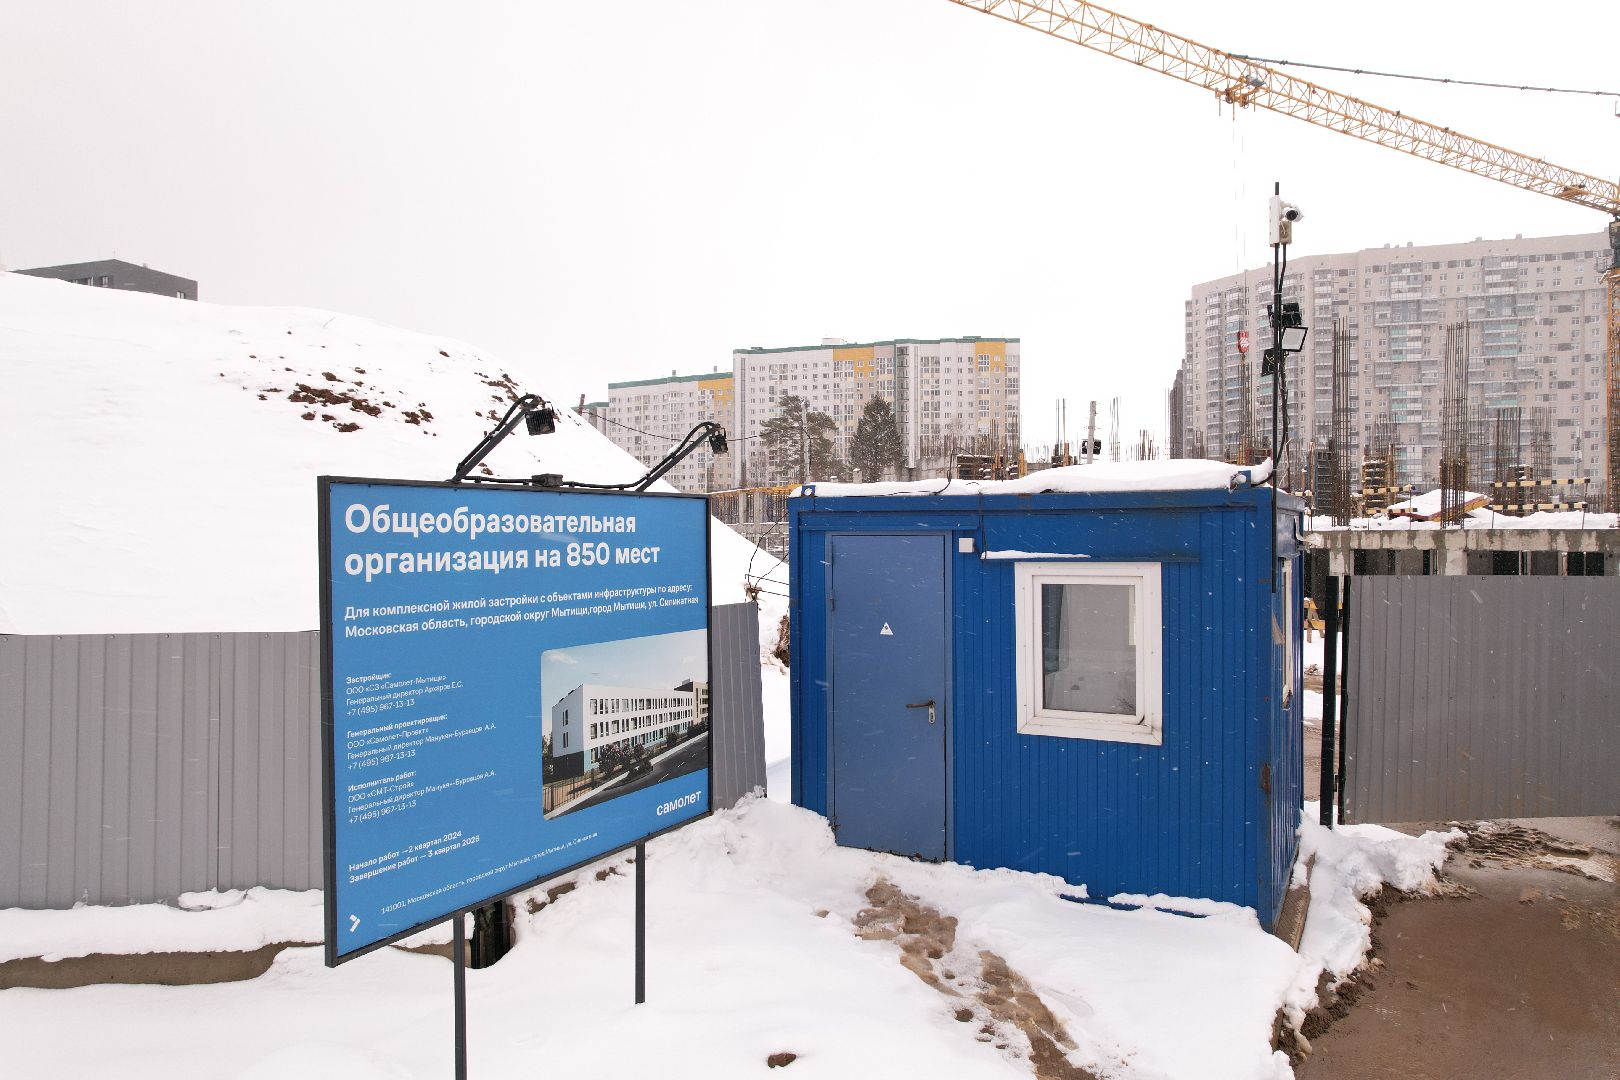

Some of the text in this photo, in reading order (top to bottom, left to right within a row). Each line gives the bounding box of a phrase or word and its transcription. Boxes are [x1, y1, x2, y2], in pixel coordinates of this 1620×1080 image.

[345, 503, 636, 539] Общеобразовательная
[345, 542, 660, 582] организация на 850 мест
[344, 606, 370, 621] Для
[372, 599, 450, 617] комплексной
[452, 597, 486, 610] жилой
[488, 593, 539, 608] застройки
[547, 591, 593, 602] объектами
[594, 586, 657, 600] инфраструктуры
[658, 586, 667, 594] по
[667, 584, 693, 593] адресу:
[345, 622, 419, 638] Московская
[422, 618, 468, 631] область,
[470, 610, 522, 628] городской
[524, 611, 549, 622] округ
[614, 601, 647, 612] Мытищи,
[648, 600, 658, 610] ул.
[659, 596, 699, 607] Силикатная
[346, 672, 392, 684] Застройщик:
[346, 687, 363, 695] ООО
[347, 692, 392, 706] Генеральный
[393, 688, 423, 699] директор
[347, 699, 415, 716] +7 (495) 967-13-13
[347, 714, 447, 738] Генеральный проектировщик:
[347, 745, 392, 760] Генеральный
[393, 738, 424, 750] директор
[484, 722, 496, 730] А.А.
[347, 741, 365, 749] ООО
[348, 749, 416, 770] +7 (495) 967-13-13
[348, 770, 417, 792] Исполнитель работ:
[348, 797, 393, 813] Генеральный
[394, 789, 425, 801] директор
[484, 770, 496, 778] А.А.
[348, 793, 365, 803] ООО
[657, 791, 701, 816] самолет
[349, 800, 417, 824] +7 (495) 967-13-13
[349, 858, 377, 872] Начало
[378, 851, 400, 864] работ
[414, 838, 441, 851] квартал
[444, 831, 462, 842] 2024
[349, 863, 397, 883] Завершение
[397, 855, 419, 869] работ
[428, 850, 433, 858] 3
[434, 842, 461, 855] квартал
